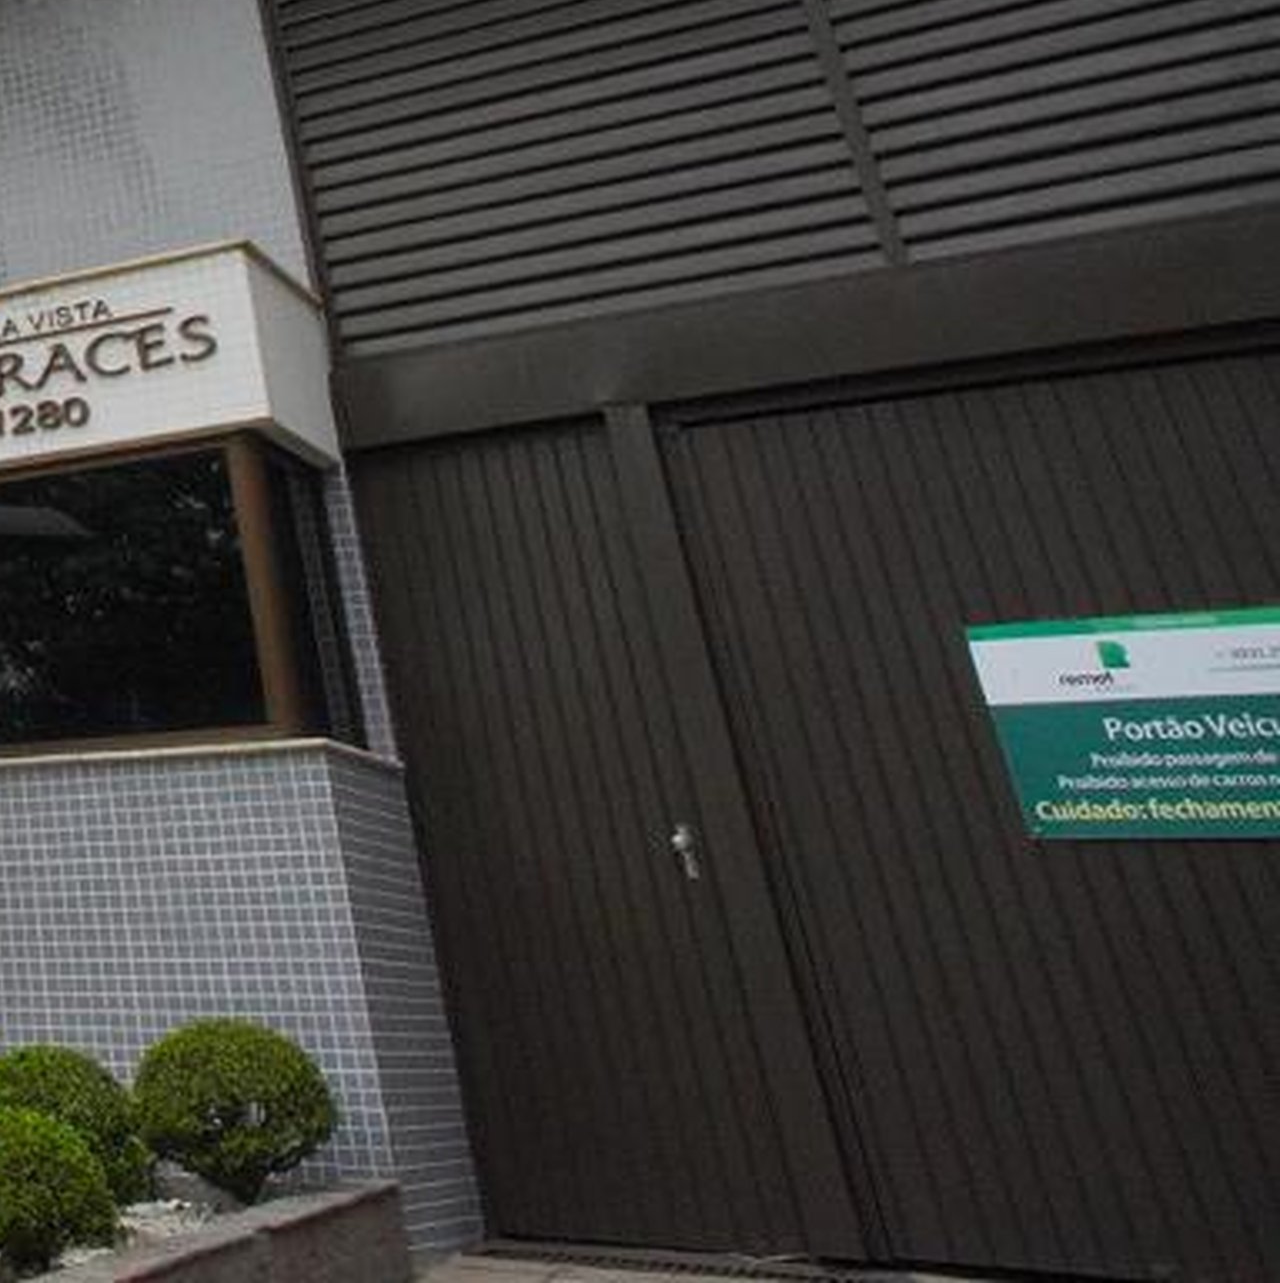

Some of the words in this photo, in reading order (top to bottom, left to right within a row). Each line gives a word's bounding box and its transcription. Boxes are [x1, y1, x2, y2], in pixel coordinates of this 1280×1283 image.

[28, 299, 114, 332] VISTA
[1102, 716, 1205, 741] Portão
[1035, 798, 1148, 821] Cuidado:
